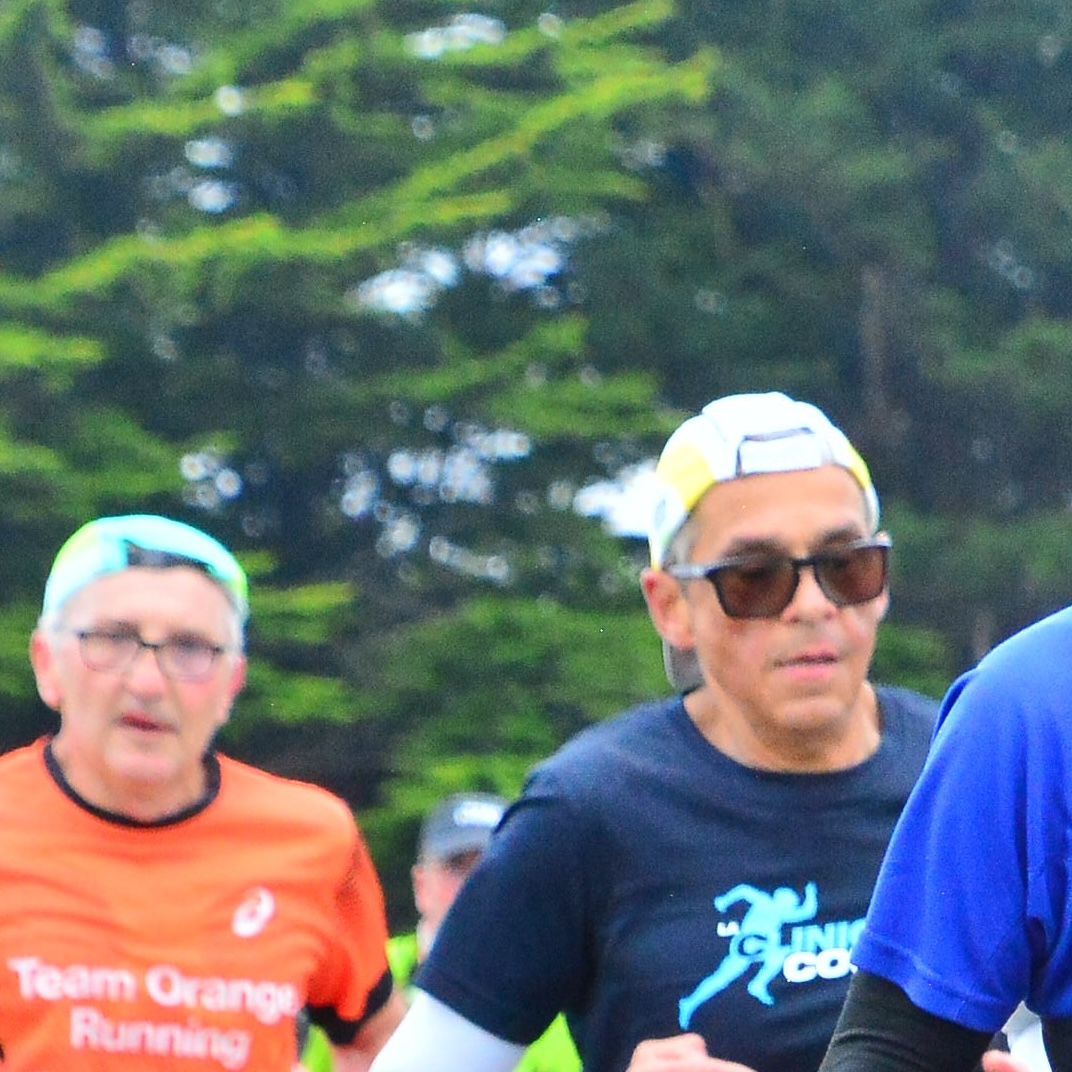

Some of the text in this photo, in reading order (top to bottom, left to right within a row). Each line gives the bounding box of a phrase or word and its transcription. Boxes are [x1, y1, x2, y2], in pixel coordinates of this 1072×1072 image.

[7, 955, 299, 1025] Team Orange
[70, 1005, 250, 1071] Running
